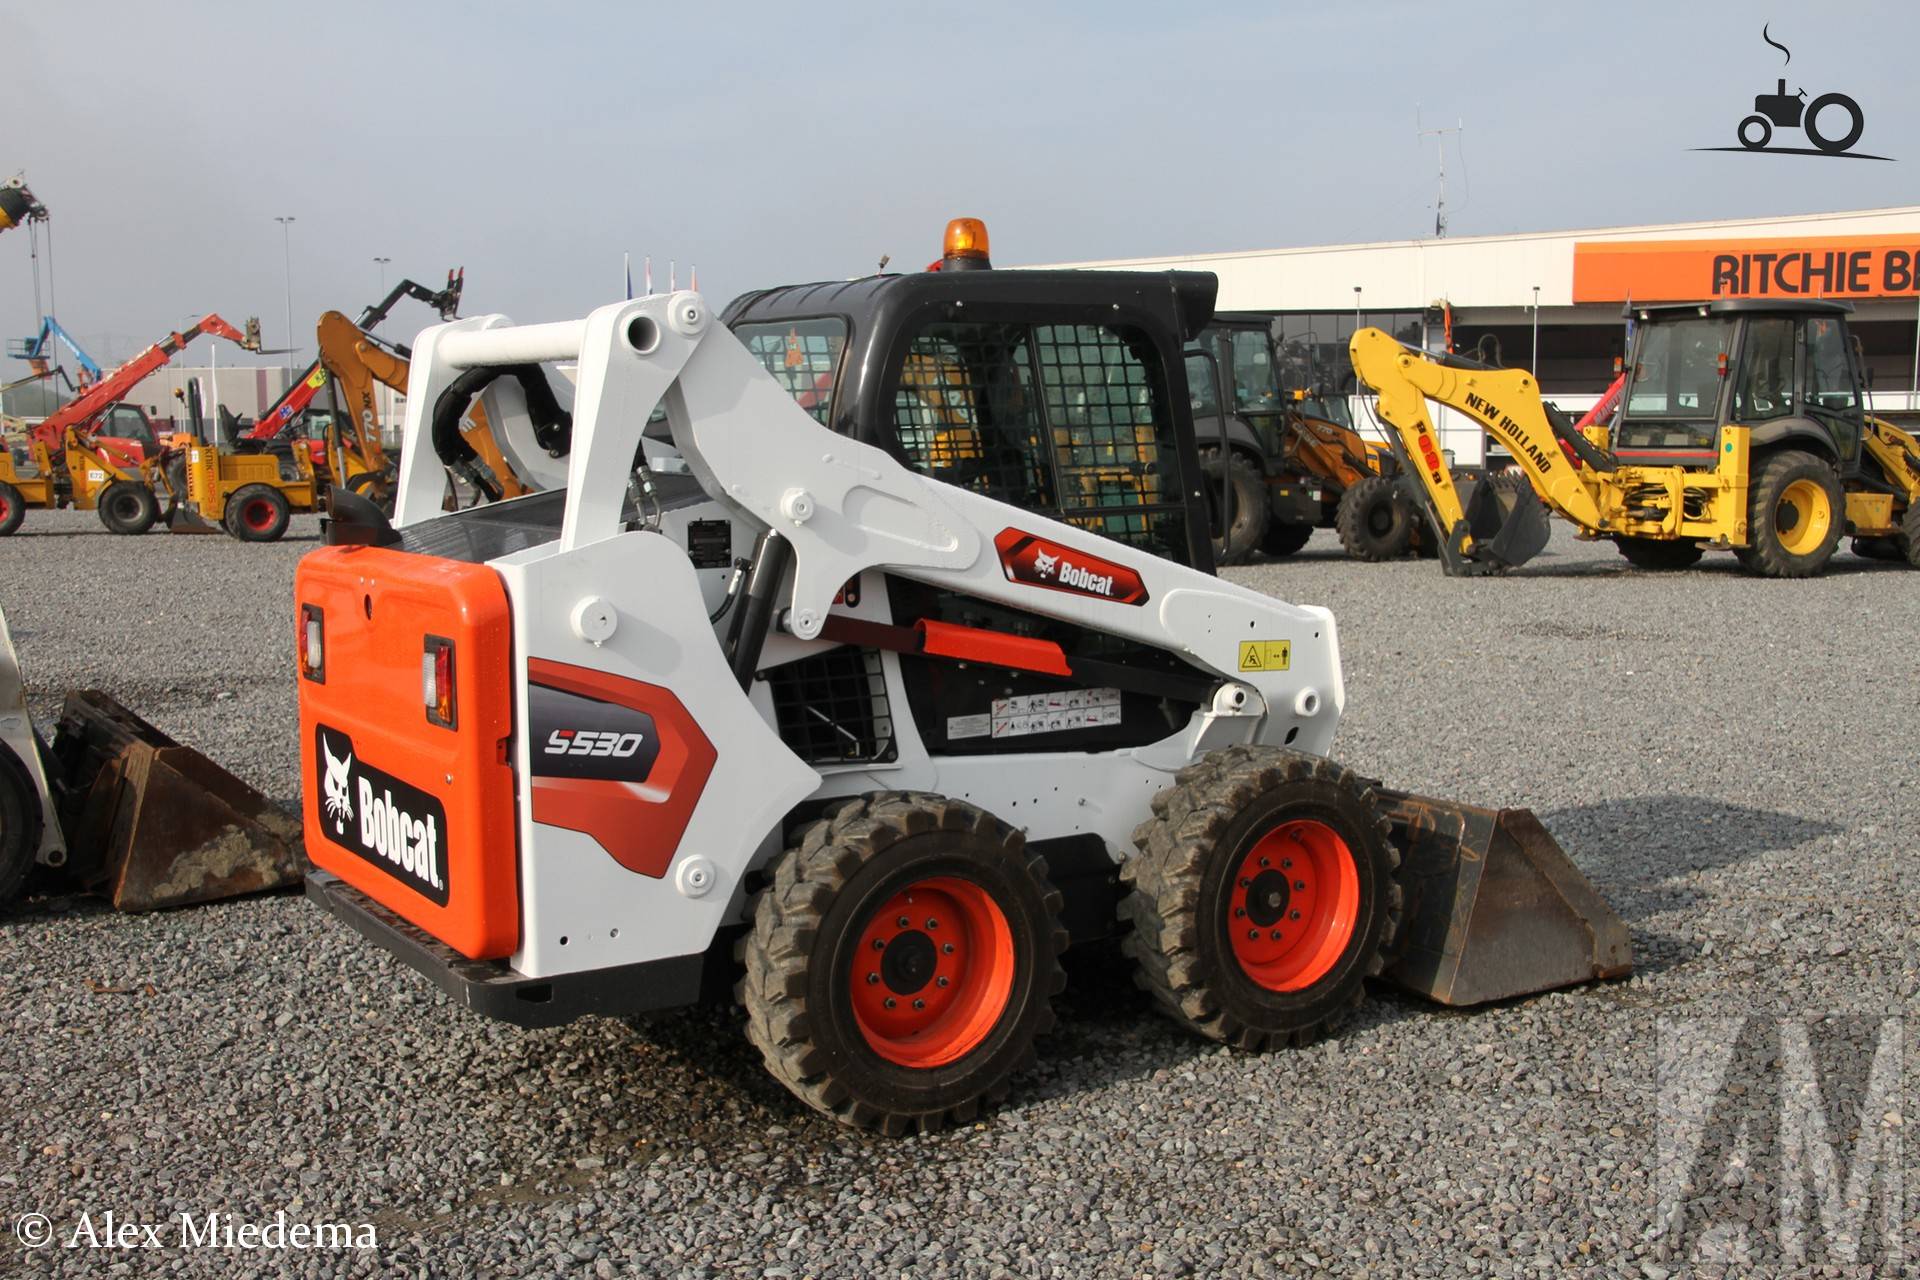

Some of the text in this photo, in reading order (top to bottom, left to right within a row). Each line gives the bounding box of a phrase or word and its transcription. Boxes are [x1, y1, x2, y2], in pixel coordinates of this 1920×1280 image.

[1712, 250, 1920, 295] RITCHIE B
[1465, 392, 1552, 474] NEW HOLLAND
[1059, 561, 1113, 596] Bobcat
[544, 729, 643, 758] S530
[358, 775, 439, 888] Bobcat
